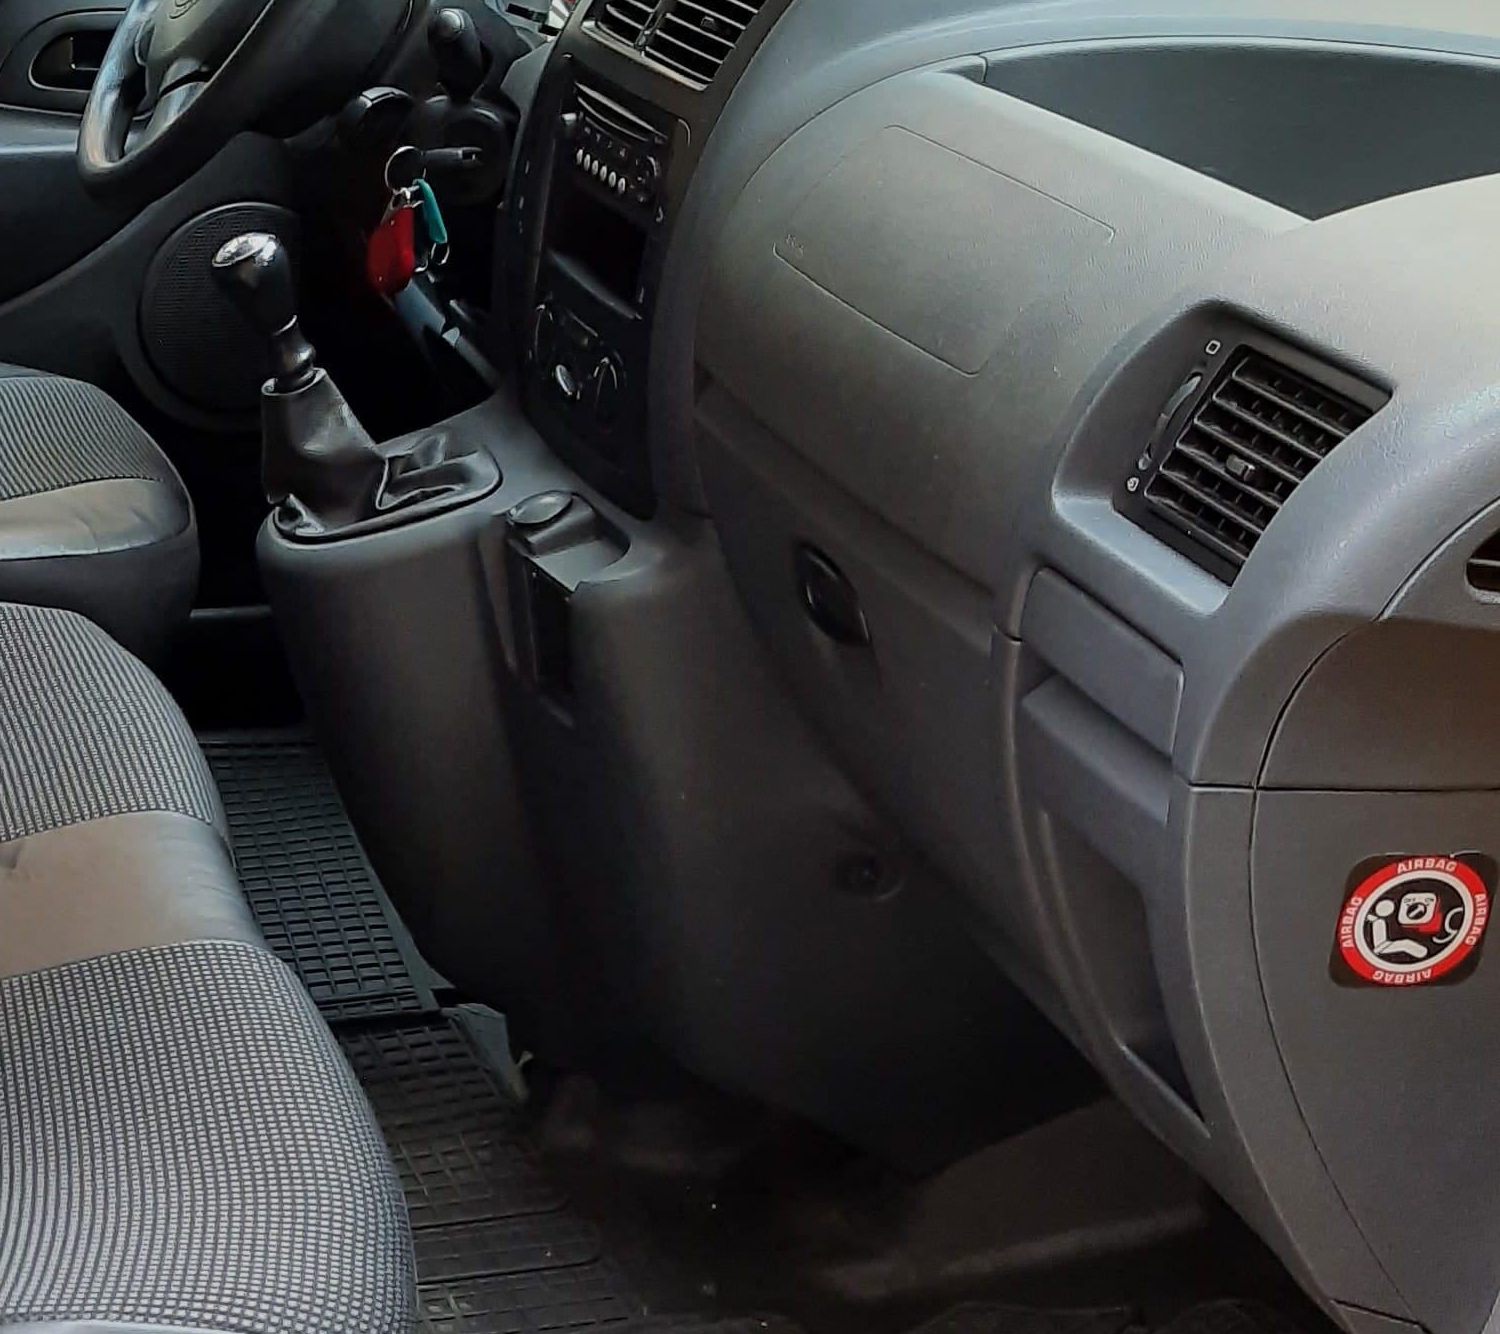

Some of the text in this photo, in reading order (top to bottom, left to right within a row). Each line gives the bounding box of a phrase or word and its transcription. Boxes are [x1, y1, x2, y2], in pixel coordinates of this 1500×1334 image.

[1396, 857, 1458, 874] AIRBAG
[1340, 895, 1364, 949] AIRBAG
[1464, 892, 1488, 947] AIRBAG
[1371, 968, 1433, 985] AIRBAG
